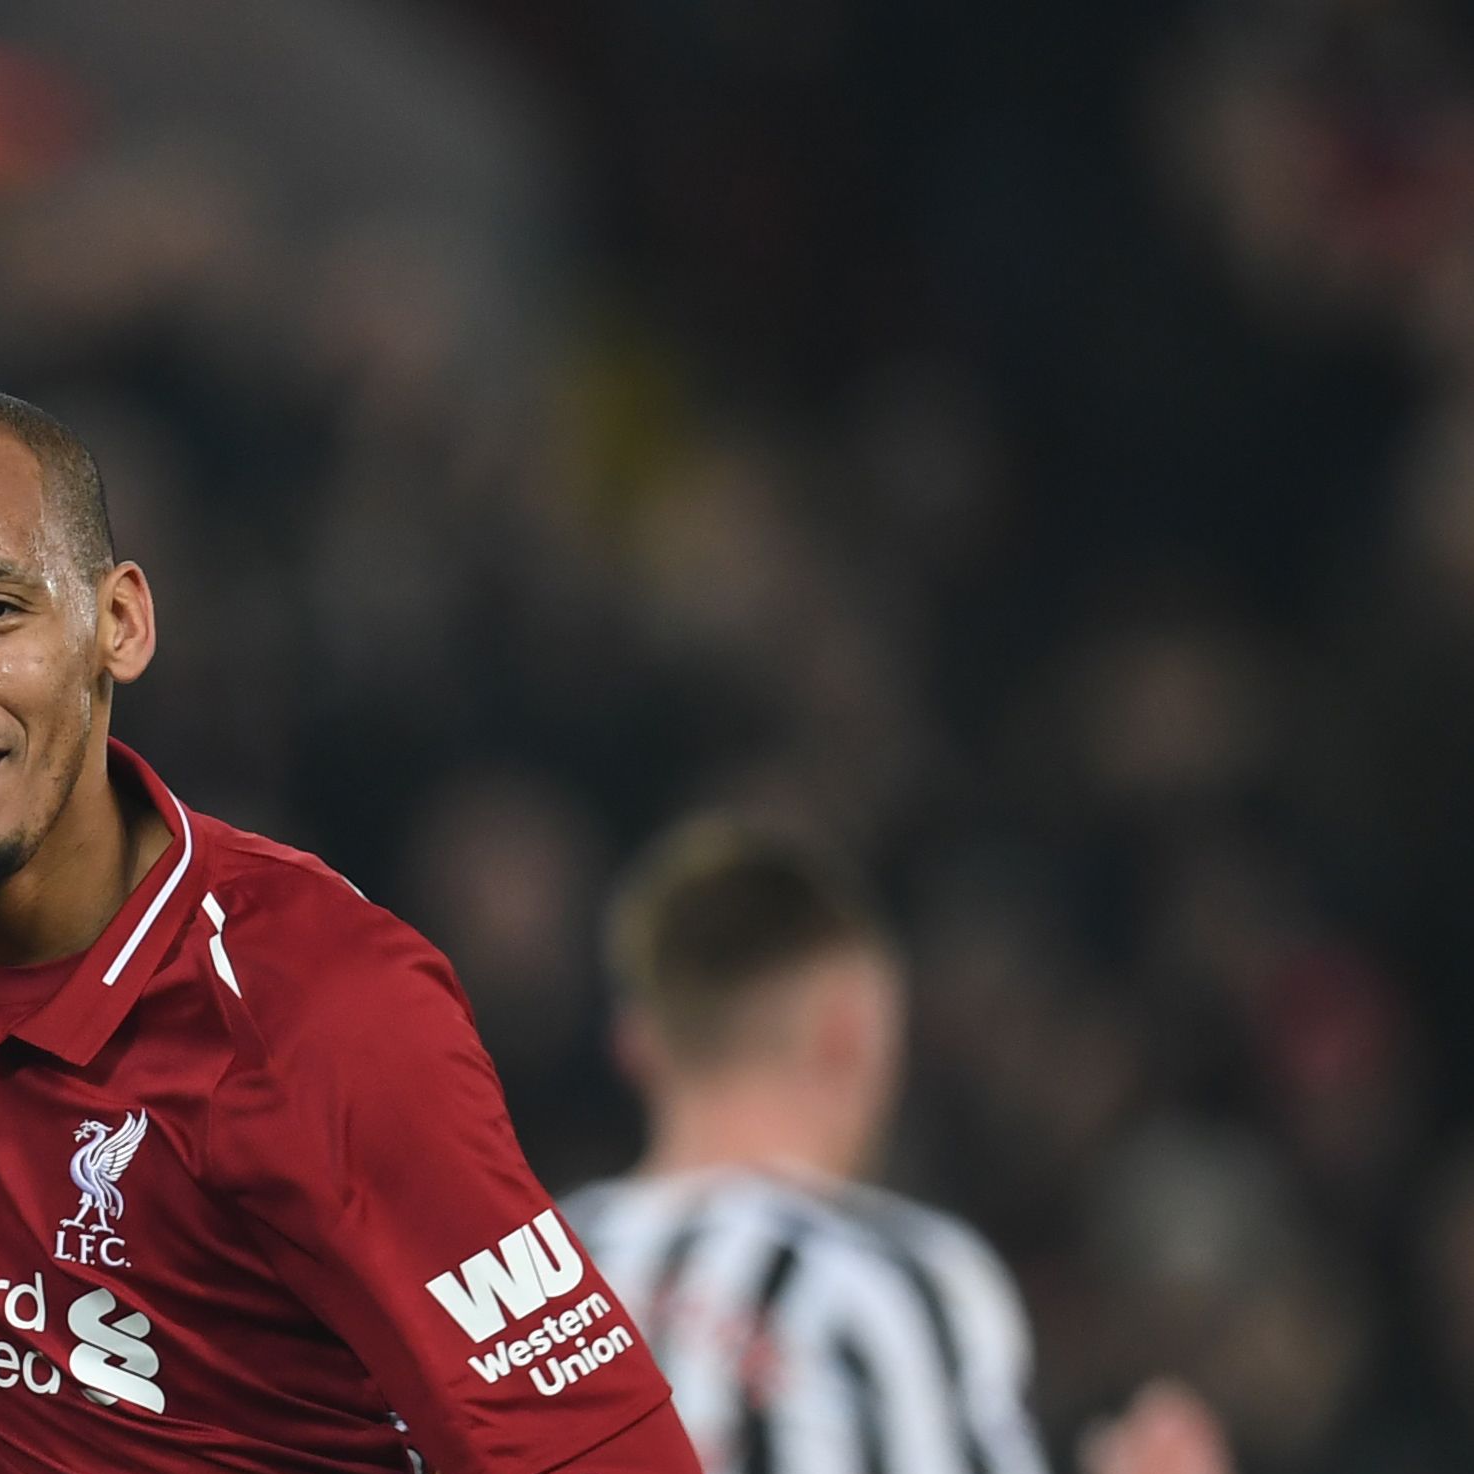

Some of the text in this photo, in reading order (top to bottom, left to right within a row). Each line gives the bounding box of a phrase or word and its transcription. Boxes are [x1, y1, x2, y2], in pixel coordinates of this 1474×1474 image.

[425, 1208, 584, 1344] WU
[467, 1291, 611, 1384] Western
[528, 1324, 634, 1396] Union
